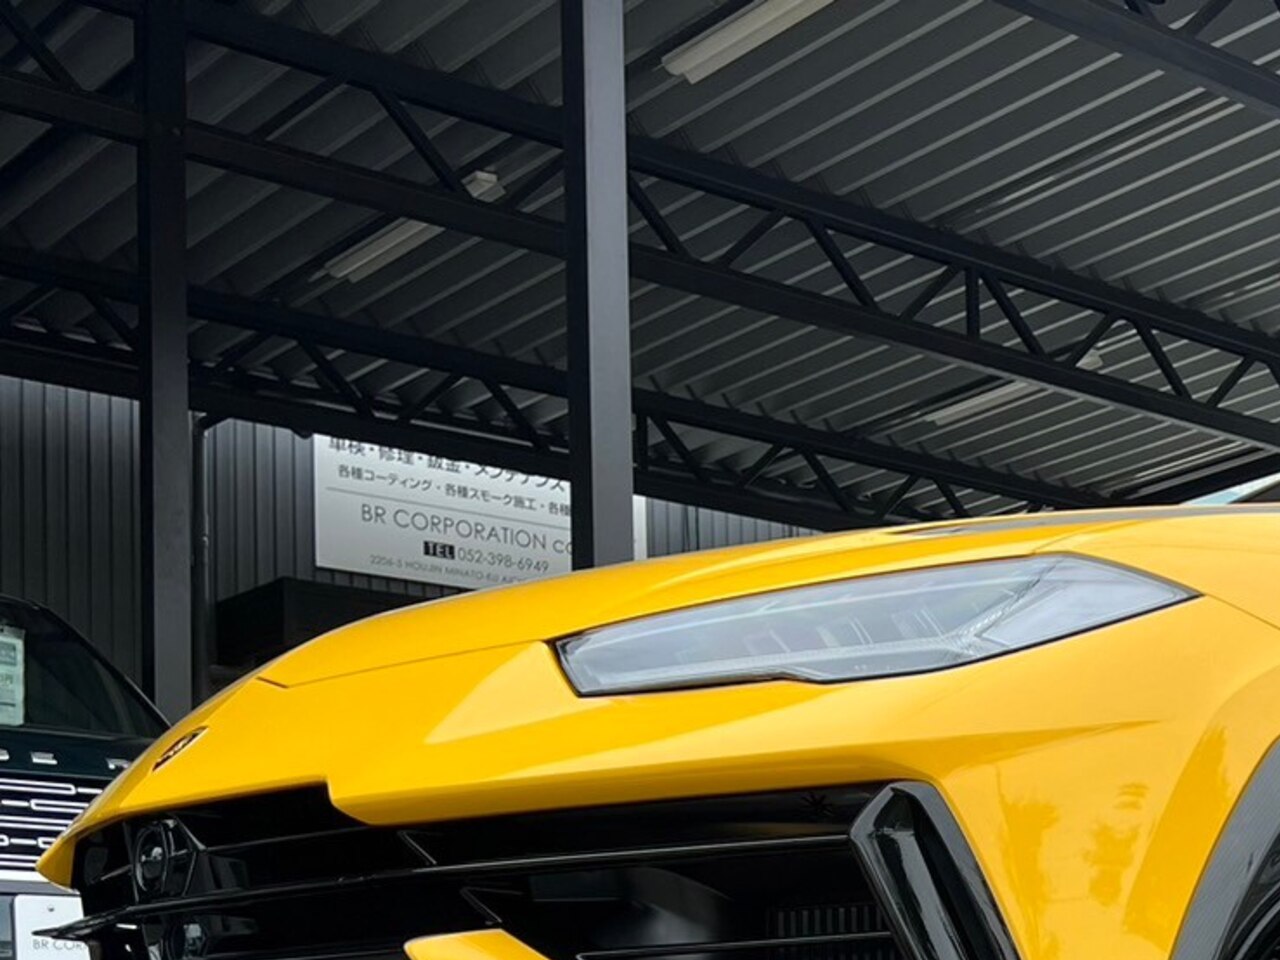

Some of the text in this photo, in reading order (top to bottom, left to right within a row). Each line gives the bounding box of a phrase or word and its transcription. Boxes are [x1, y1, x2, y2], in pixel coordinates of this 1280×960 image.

[361, 503, 386, 524] BR
[393, 508, 547, 550] CORPORATION
[425, 541, 550, 573] TEL 052-398-6949
